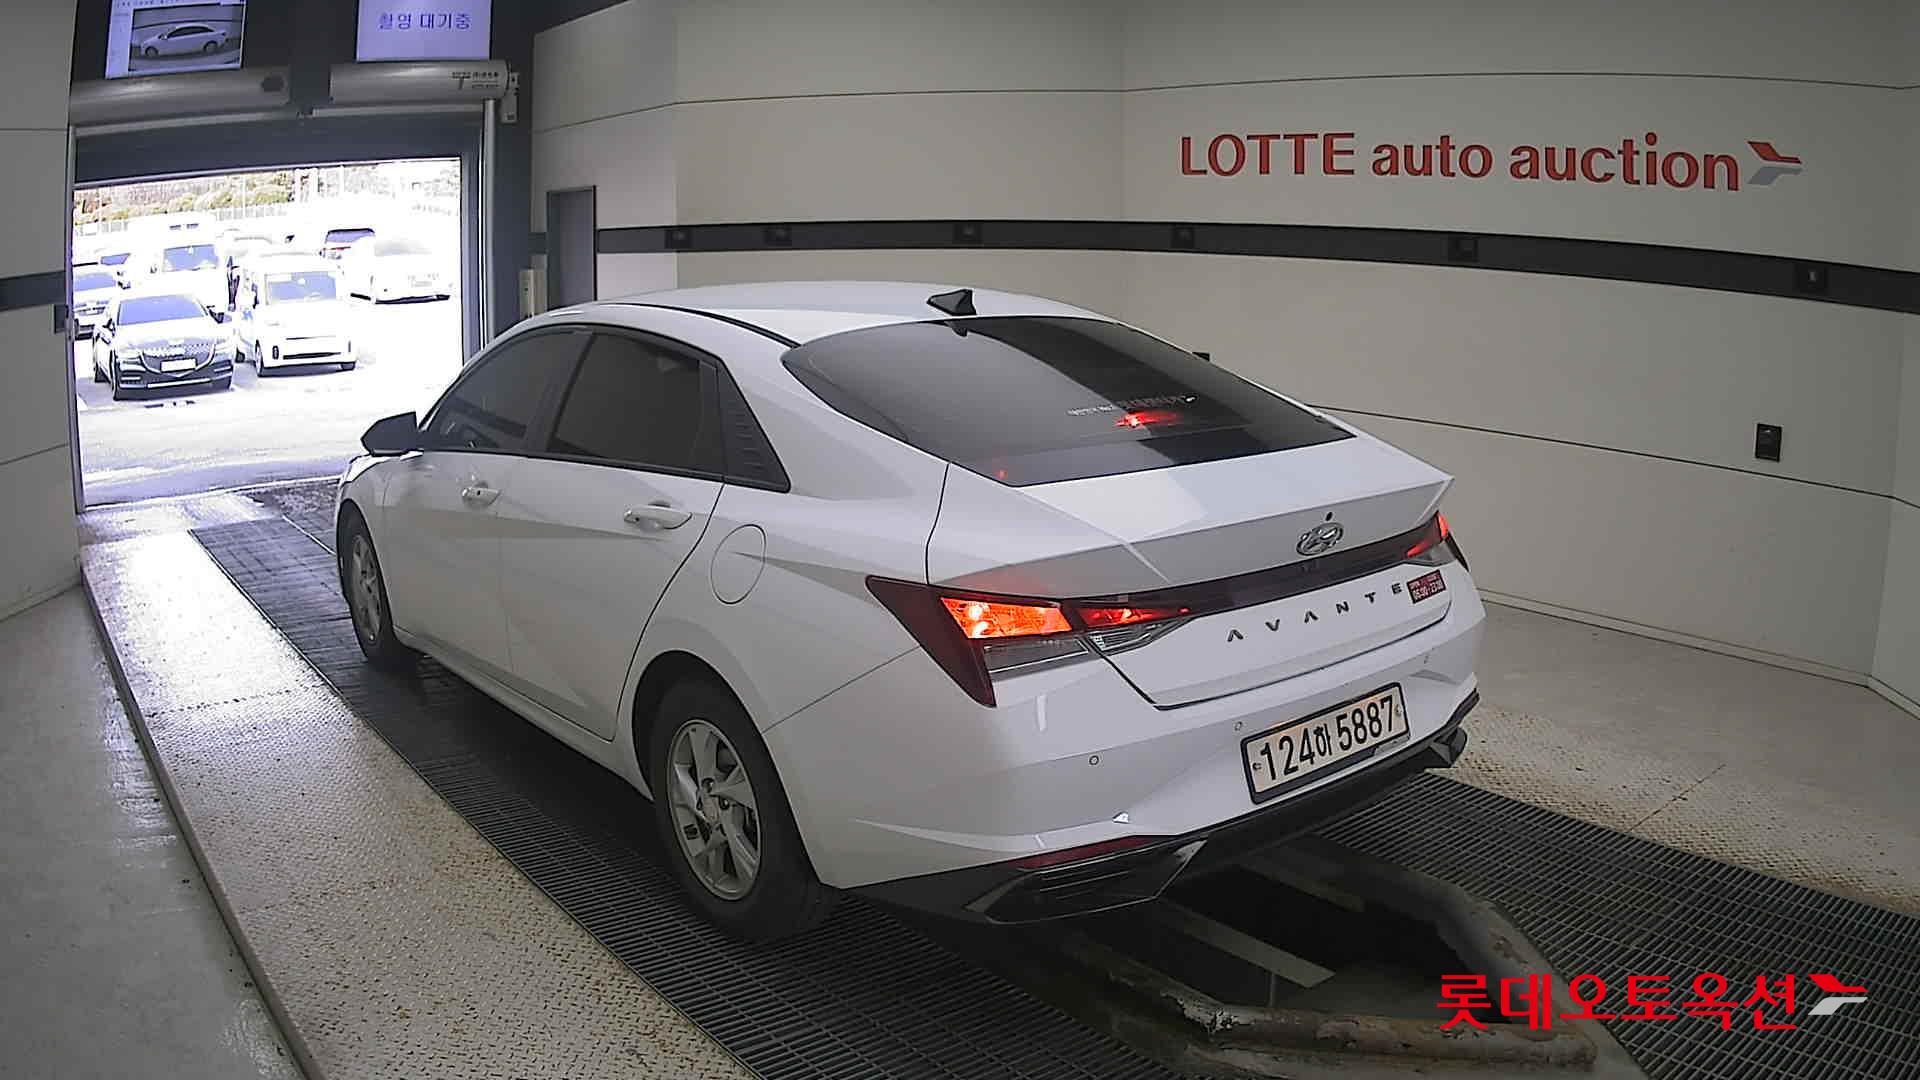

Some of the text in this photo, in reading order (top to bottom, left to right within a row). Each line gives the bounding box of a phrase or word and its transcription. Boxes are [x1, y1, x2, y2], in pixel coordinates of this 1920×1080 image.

[420, 12, 471, 30] 대기중
[1179, 131, 1741, 192] LOTTE auto auction
[1226, 582, 1403, 643] AVANTE
[1260, 694, 1394, 781] 124하 5887
